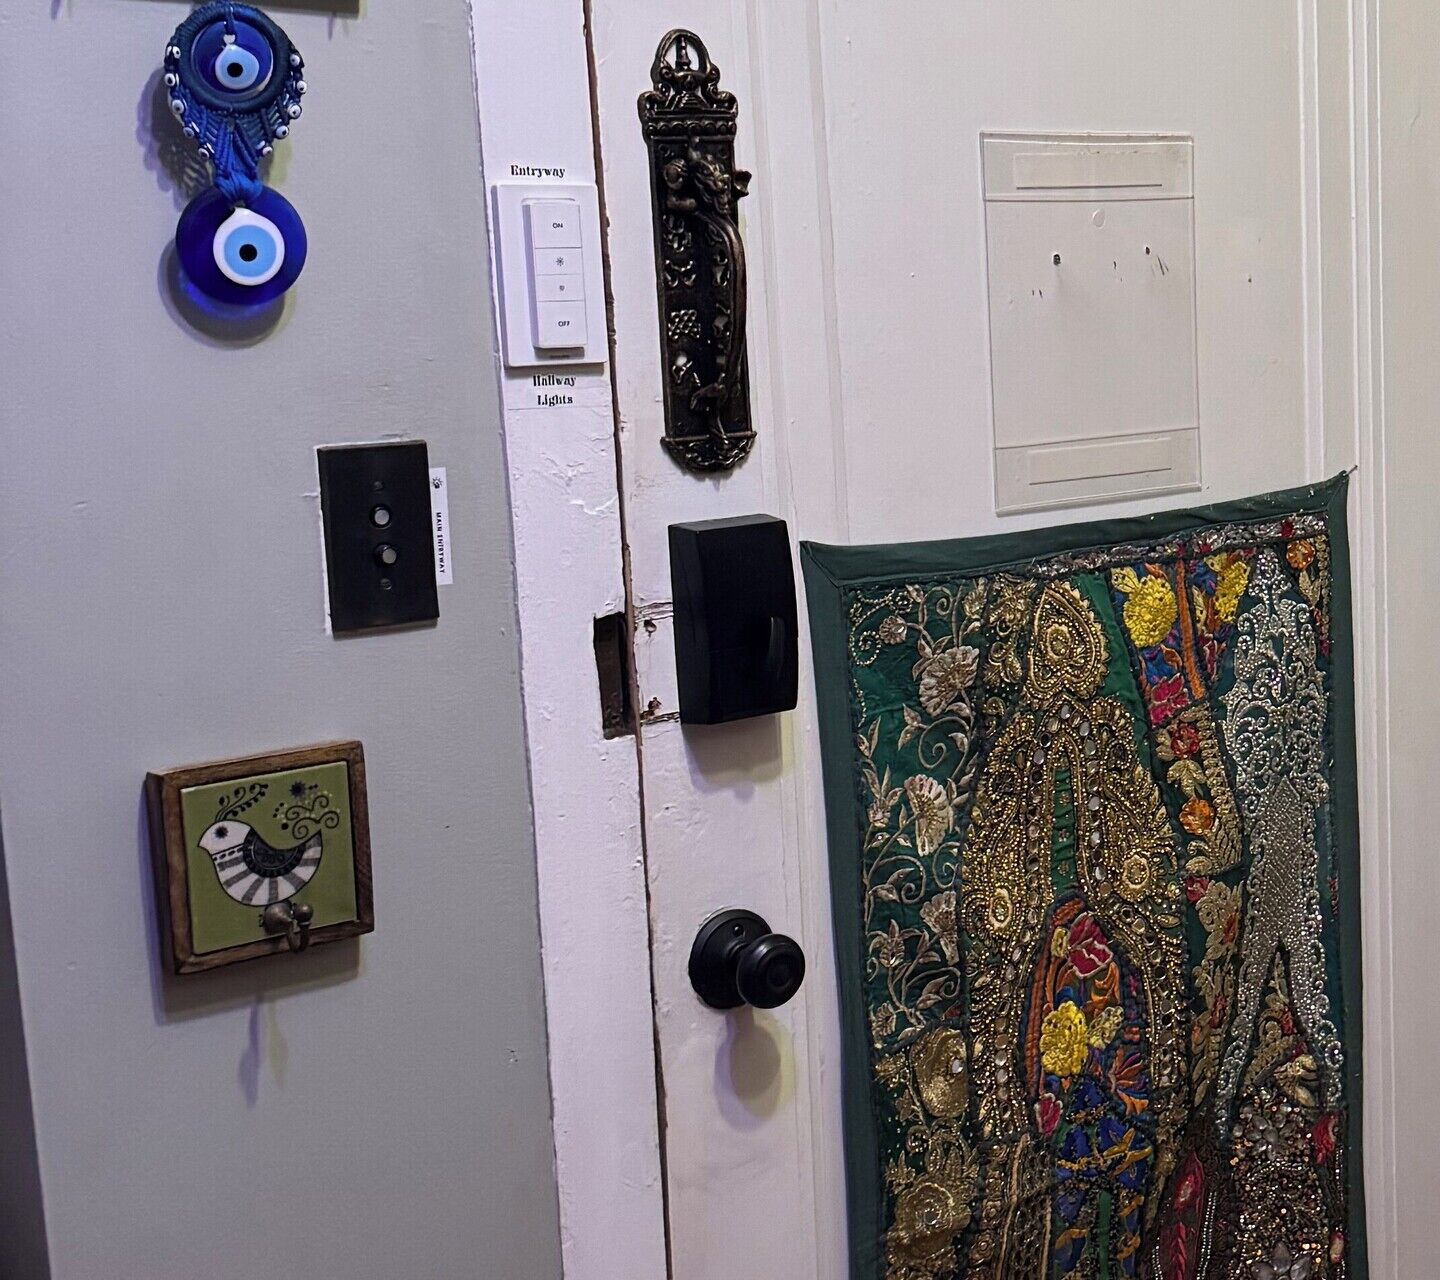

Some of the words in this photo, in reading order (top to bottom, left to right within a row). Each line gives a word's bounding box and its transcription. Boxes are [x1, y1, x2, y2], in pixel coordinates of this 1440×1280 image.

[510, 164, 566, 179] Entryway
[557, 320, 570, 328] OFF
[532, 374, 577, 387] Hallway
[537, 394, 574, 407] Lights
